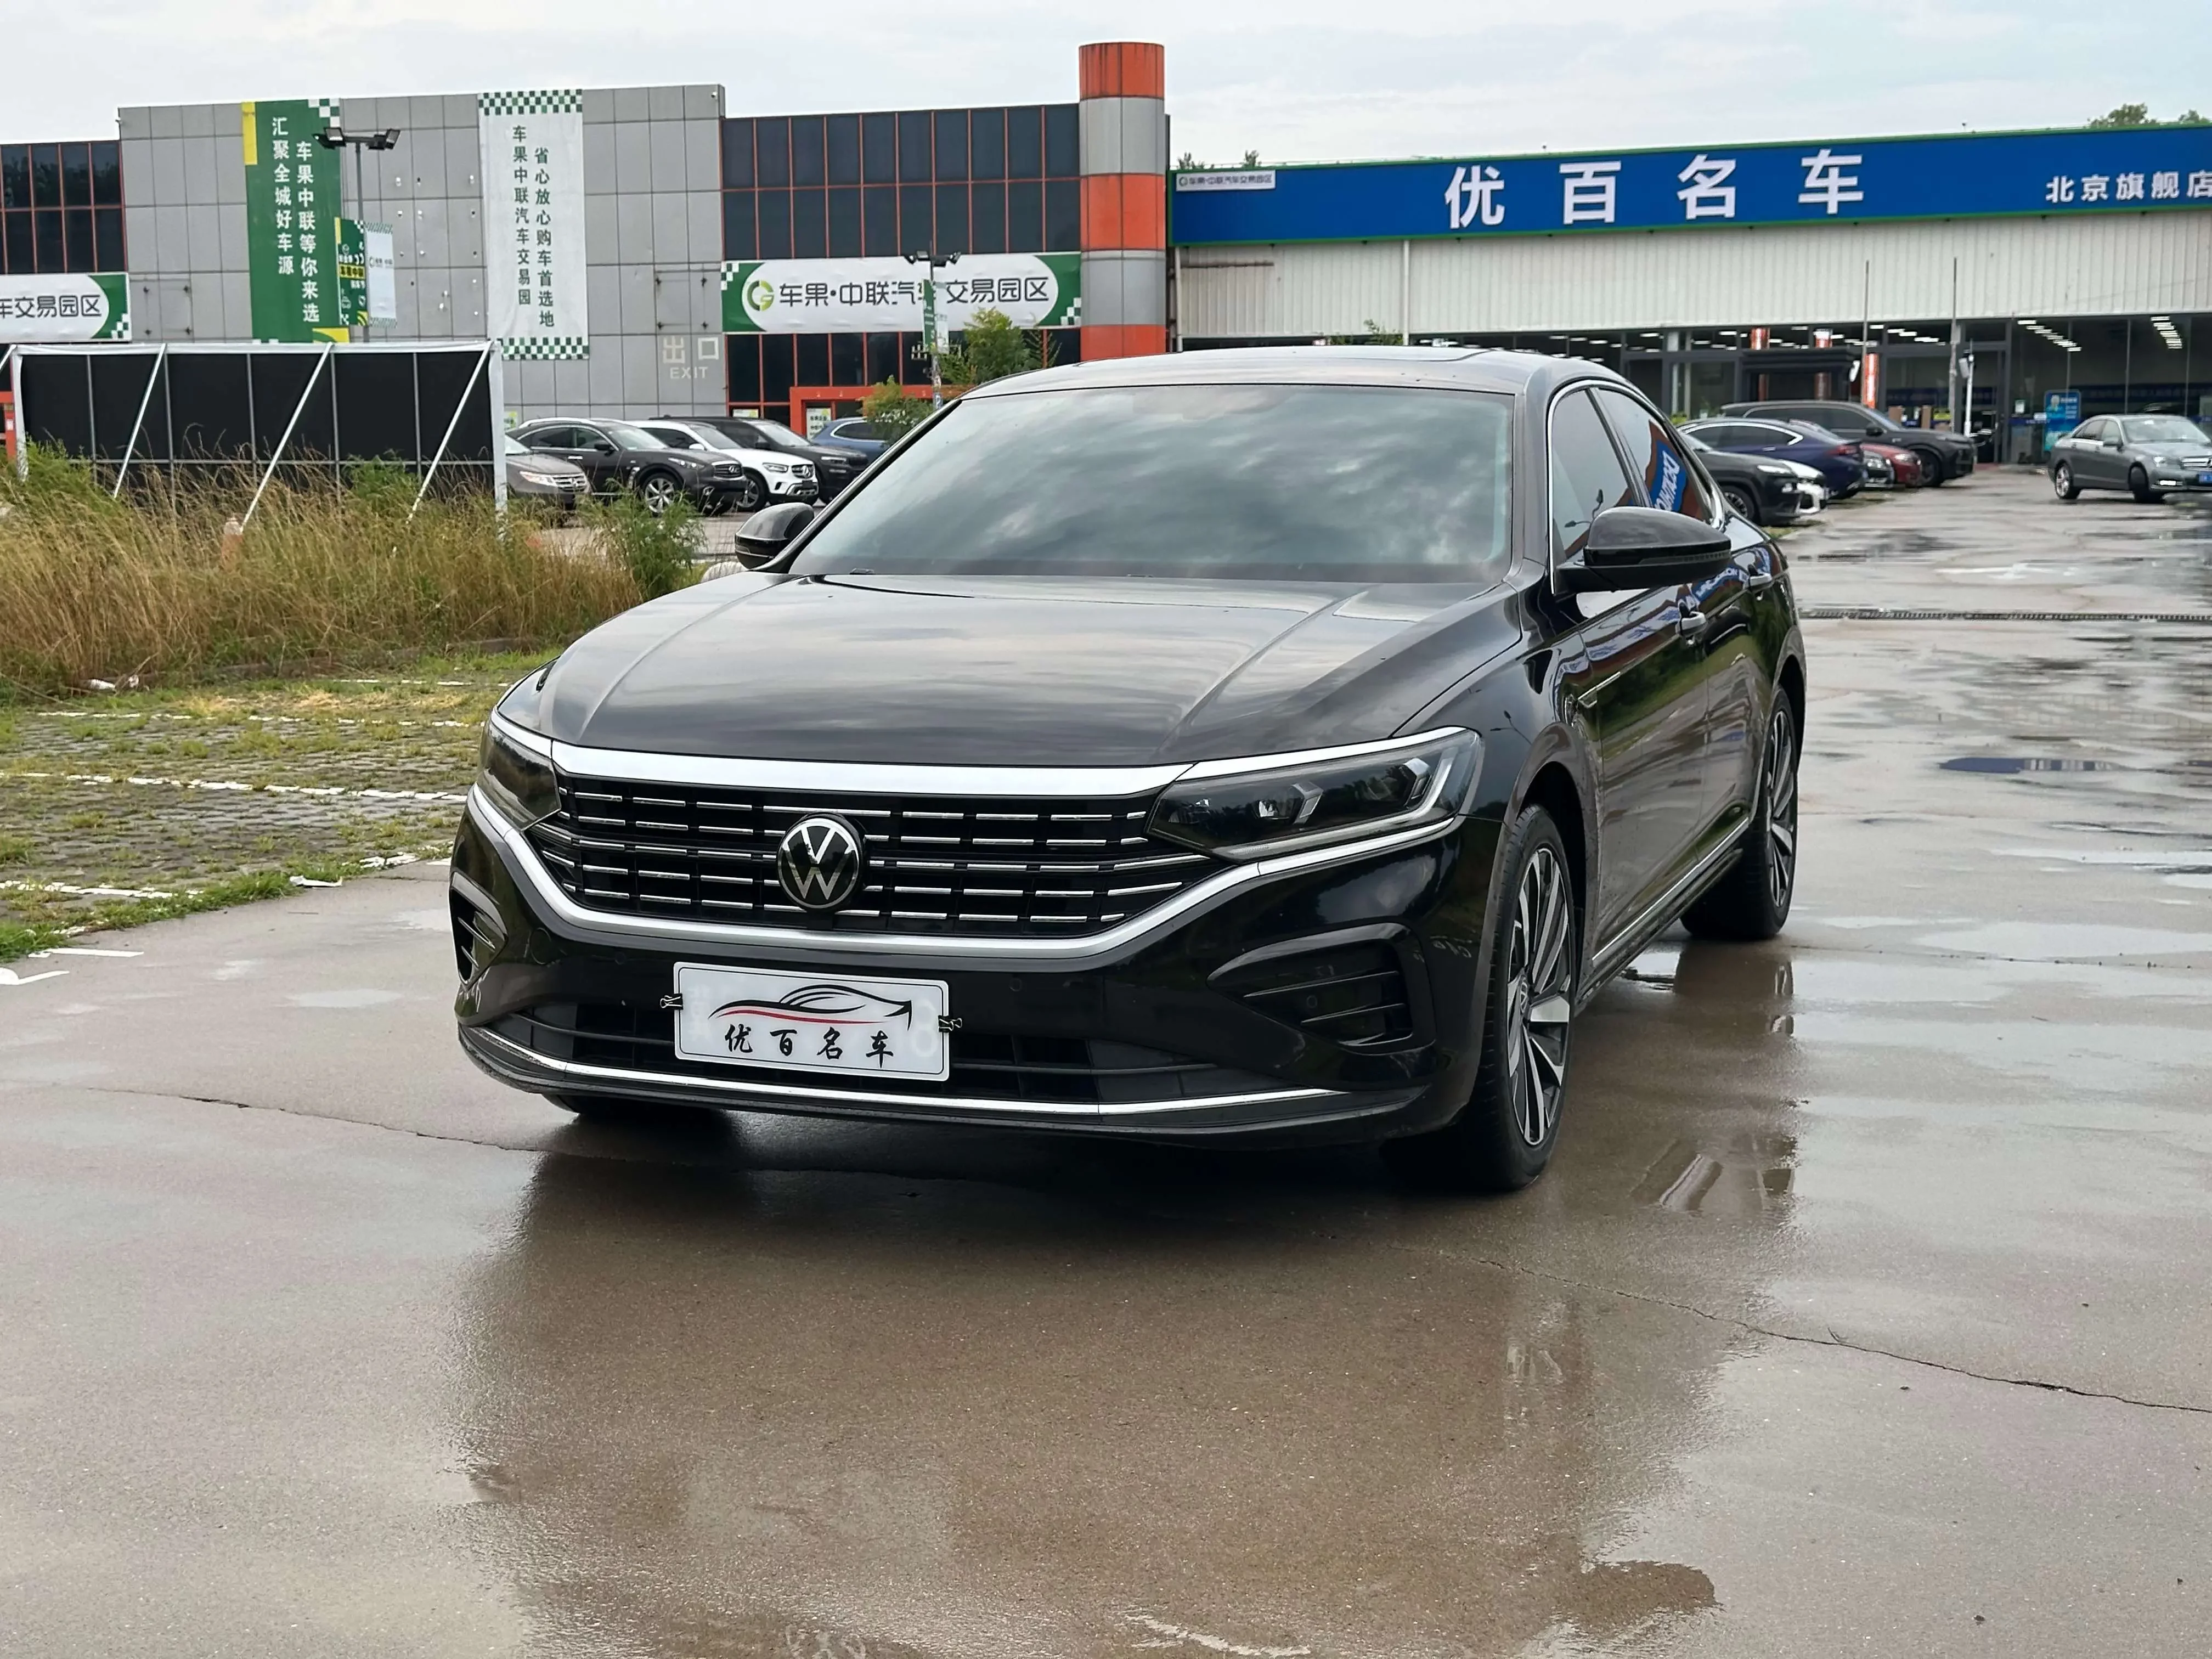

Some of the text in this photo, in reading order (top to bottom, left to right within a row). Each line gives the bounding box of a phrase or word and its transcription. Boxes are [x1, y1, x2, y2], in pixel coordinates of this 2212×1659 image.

[272, 117, 294, 274] 汇聚全城好车源
[512, 125, 531, 305] 车果中联汽车交易园
[1444, 148, 1864, 229] 优百名车
[2045, 170, 2212, 203] 北京旗舰店
[296, 140, 320, 322] 车果中联等你来选
[534, 147, 555, 327] 省心放心购车首选地
[663, 335, 719, 364] 出口
[670, 366, 708, 379] EXIT
[724, 1023, 894, 1068] 优百名车
